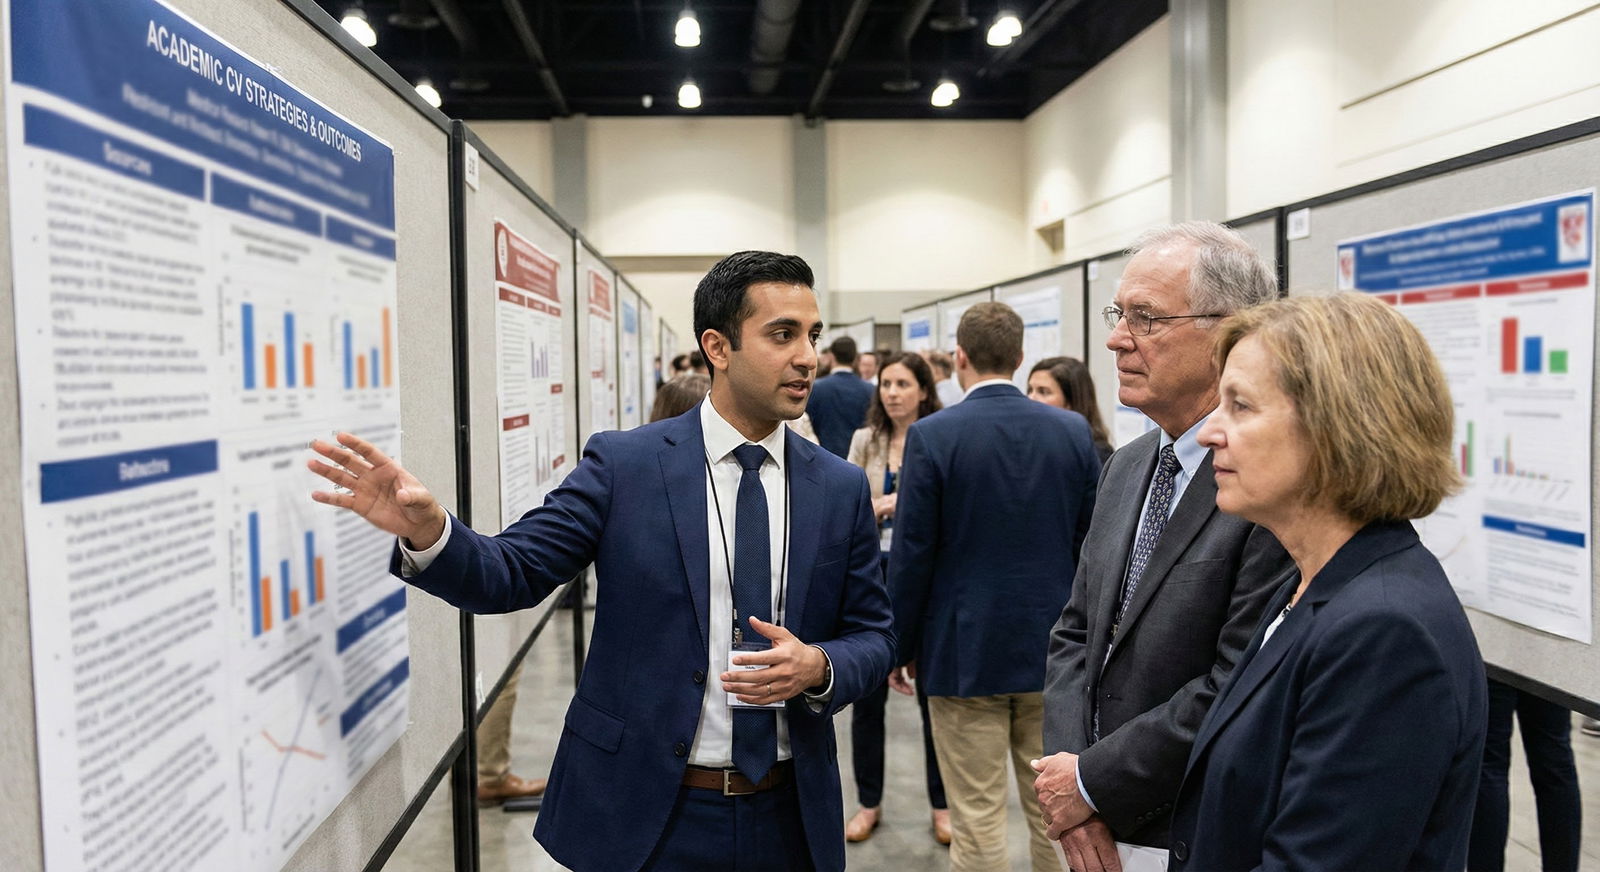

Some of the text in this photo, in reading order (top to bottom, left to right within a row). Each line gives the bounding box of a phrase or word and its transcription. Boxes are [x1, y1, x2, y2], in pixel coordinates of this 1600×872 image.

[147, 19, 223, 86] ACADEMIC
[226, 66, 243, 96] CV
[245, 77, 308, 133] STRATEGIES
[310, 115, 318, 138] &
[318, 120, 362, 162] OUTCOMES
